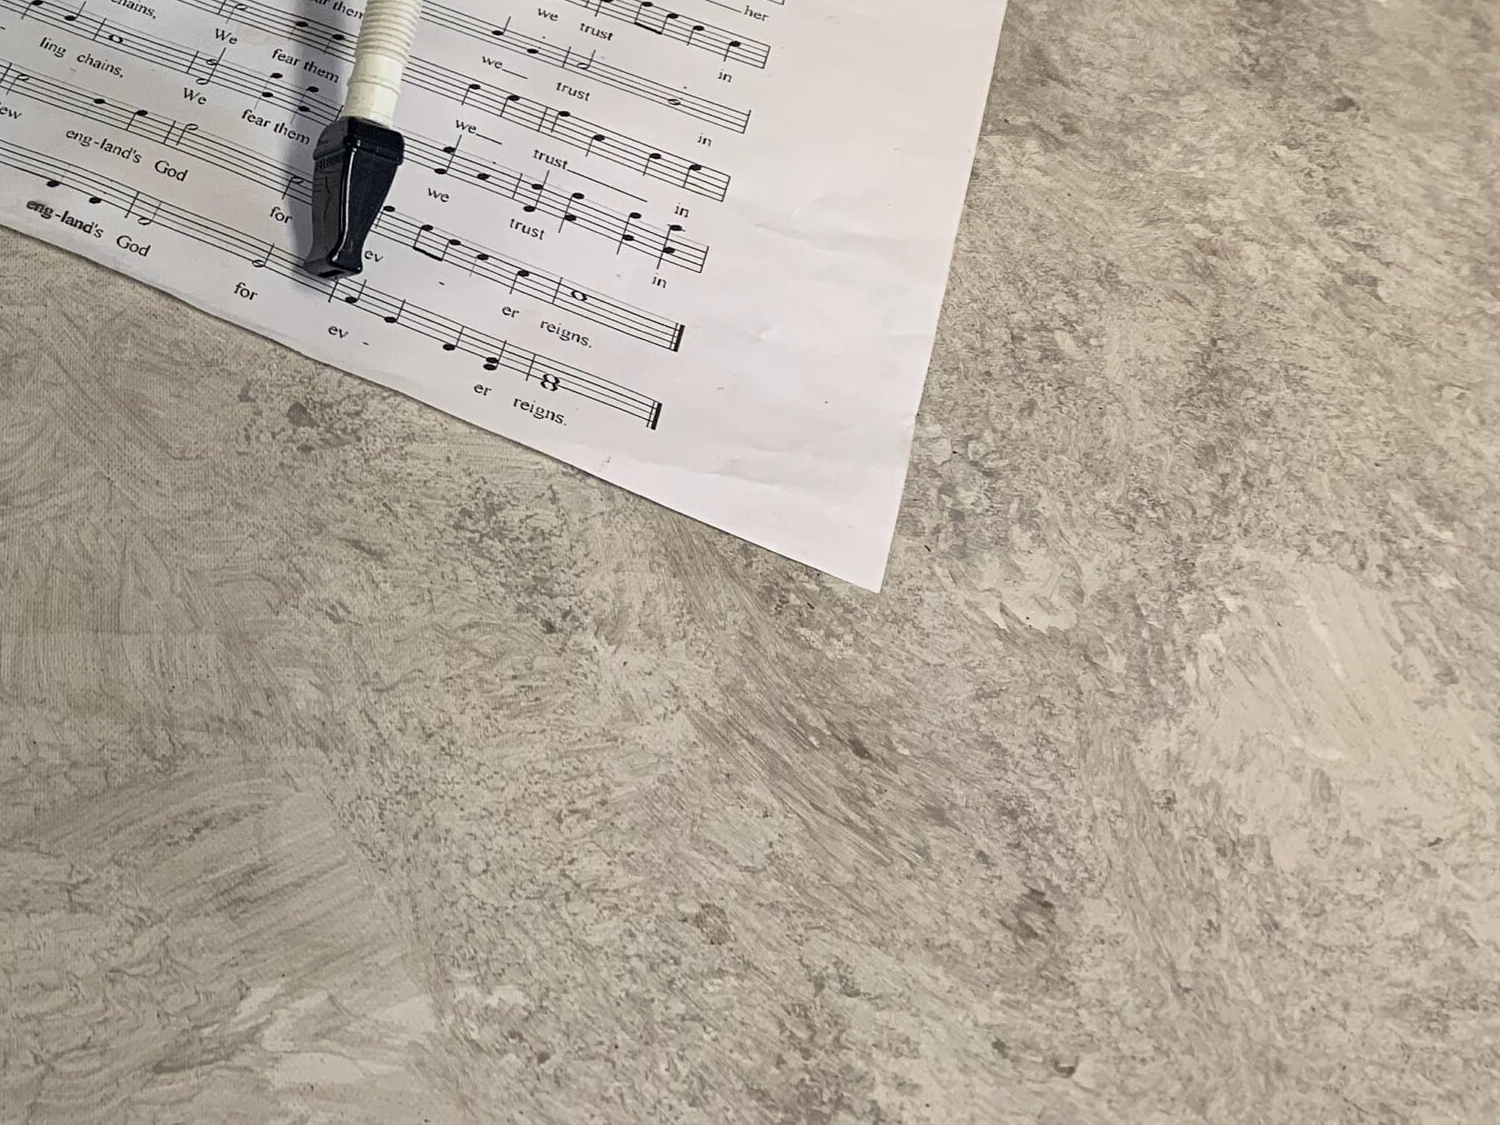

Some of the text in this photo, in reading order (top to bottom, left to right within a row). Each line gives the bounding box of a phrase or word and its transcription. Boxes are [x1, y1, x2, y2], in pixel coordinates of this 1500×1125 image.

[481, 55, 503, 70] we
[555, 81, 591, 102] trust
[696, 132, 712, 148] in
[537, 7, 559, 22] we
[579, 22, 614, 42] trust
[717, 68, 733, 83] in
[743, 4, 770, 22] her
[39, 36, 67, 59] ling
[183, 87, 207, 105] We
[241, 108, 272, 128] fear
[273, 120, 311, 145] them
[427, 187, 450, 203] we
[509, 218, 545, 241] trust
[651, 272, 667, 289] in
[215, 27, 238, 45] We
[271, 48, 301, 67] fear
[302, 60, 340, 84] them
[455, 119, 477, 135] we
[532, 149, 569, 170] trust
[673, 202, 690, 219] in
[116, 234, 152, 258] God
[233, 281, 259, 301] for
[327, 325, 349, 339] ev
[473, 383, 493, 397] er
[512, 397, 567, 427] reigns.
[154, 159, 189, 182] God
[269, 206, 293, 224] for
[363, 250, 384, 263] ev
[501, 306, 520, 319] er
[539, 320, 592, 349] reigns.
